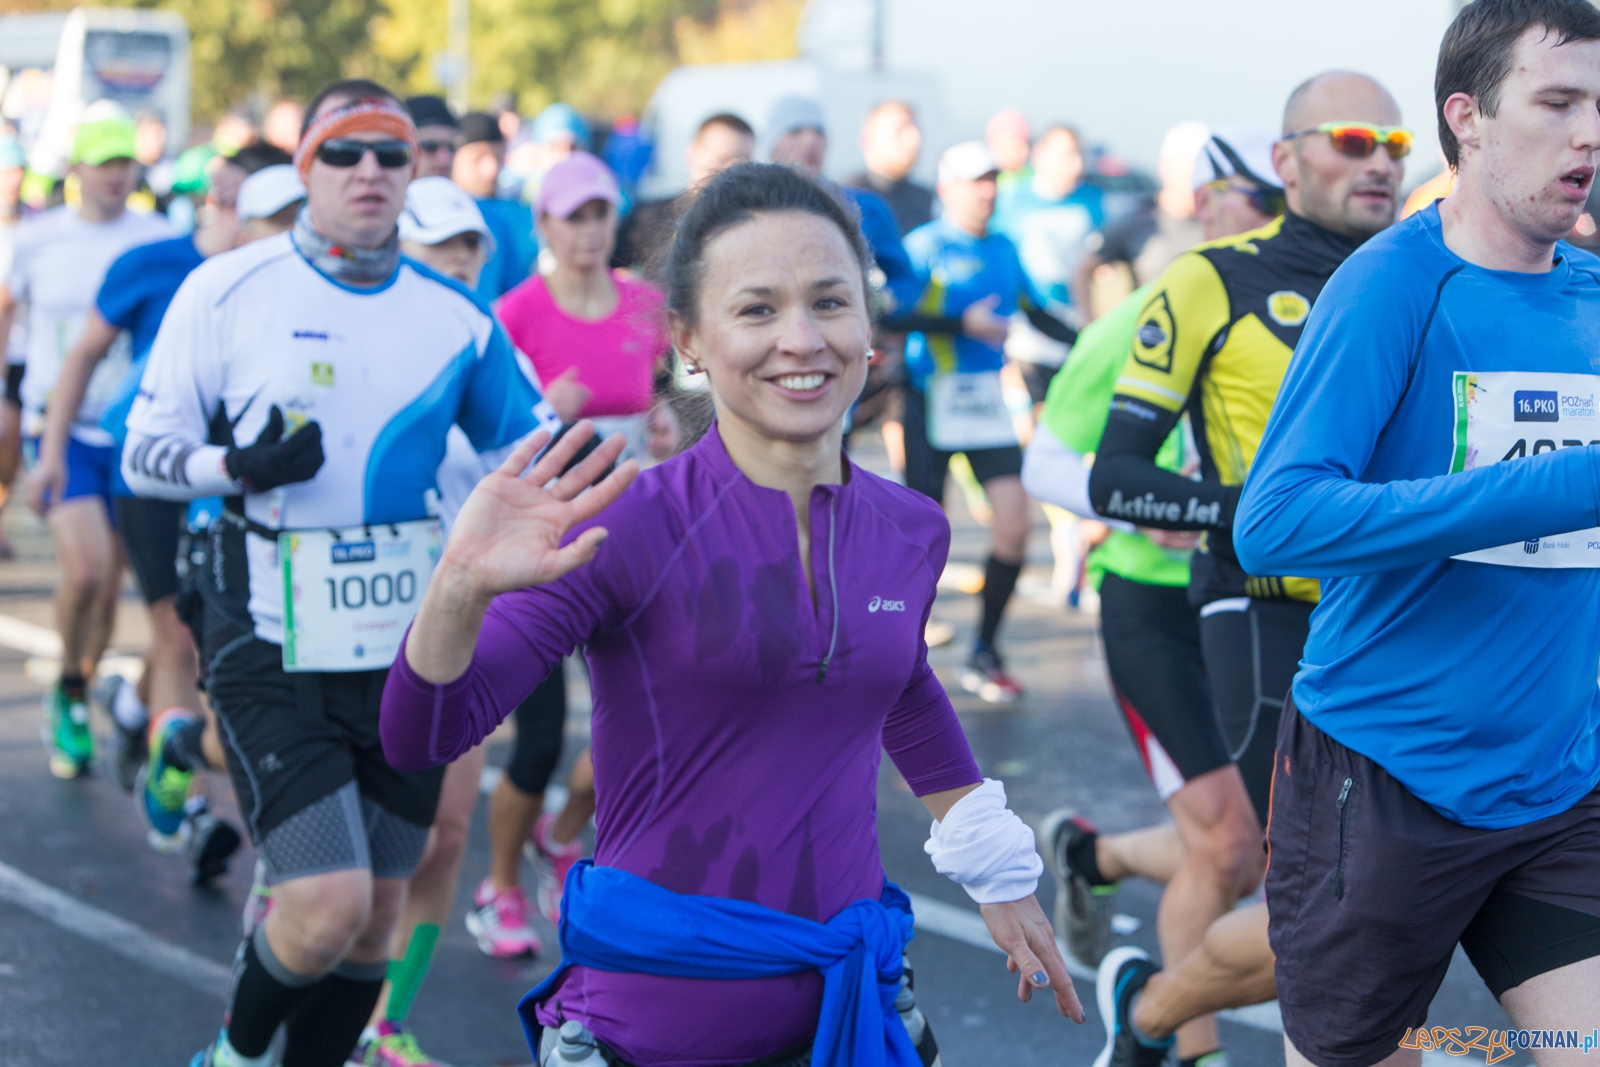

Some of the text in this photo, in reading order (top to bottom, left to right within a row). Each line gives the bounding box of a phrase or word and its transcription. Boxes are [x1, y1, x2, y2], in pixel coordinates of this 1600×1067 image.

[1563, 408, 1595, 417] maraton
[1106, 490, 1221, 525] Active Jet
[324, 570, 417, 610] 1000
[881, 599, 906, 612] asics
